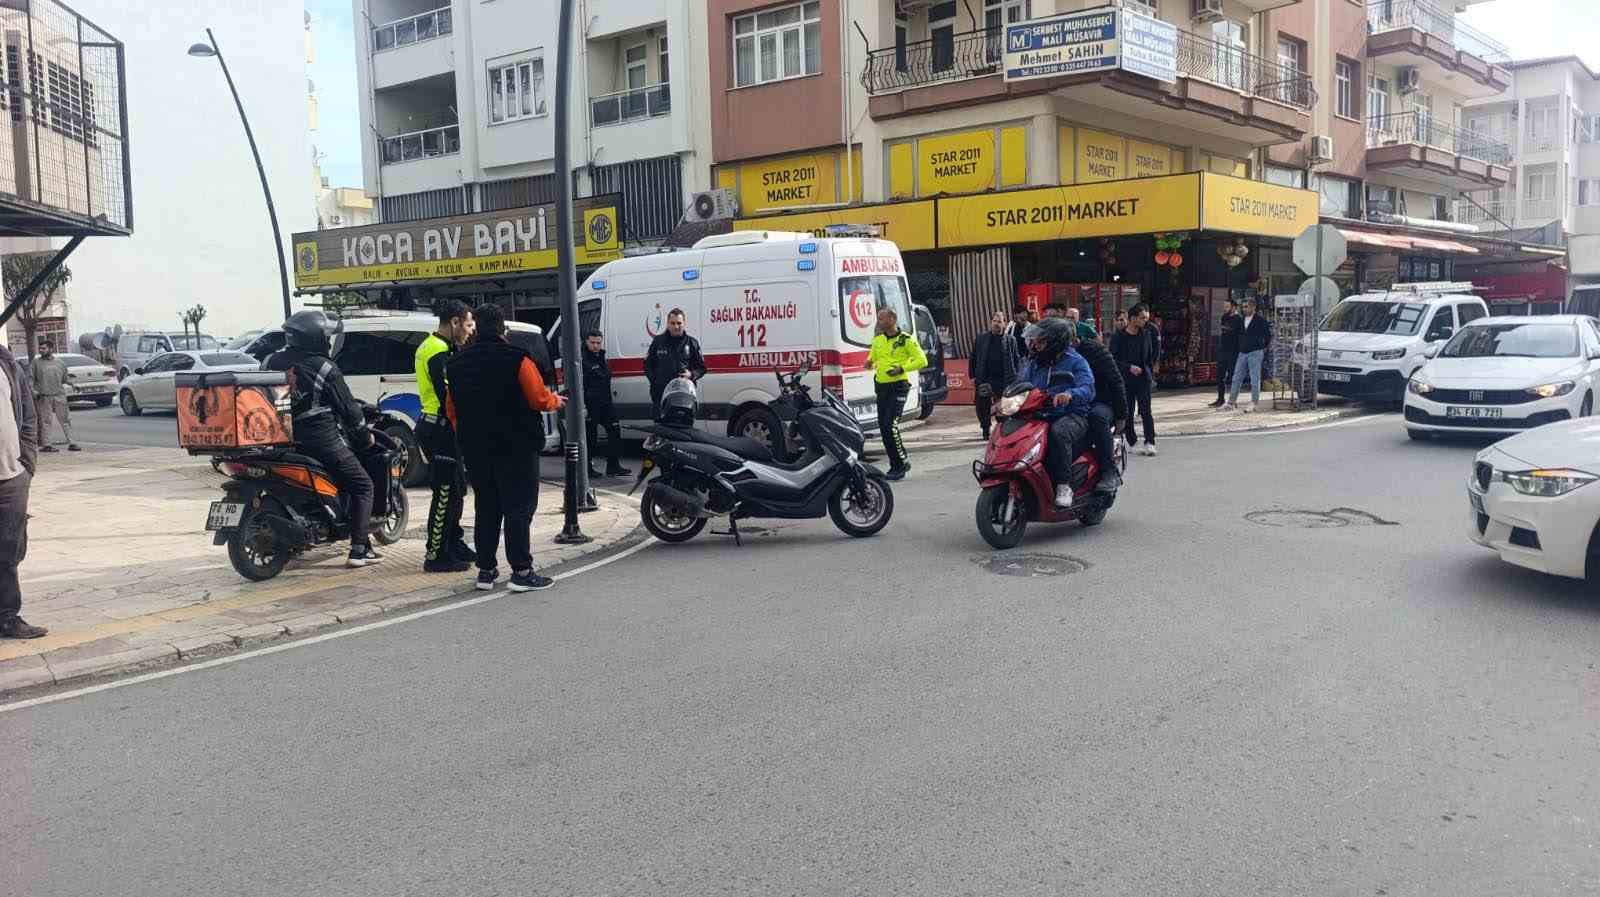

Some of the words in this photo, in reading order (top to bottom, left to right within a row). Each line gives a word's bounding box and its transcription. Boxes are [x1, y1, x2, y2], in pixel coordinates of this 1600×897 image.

[1020, 50, 1061, 66] Mehmet
[931, 151, 957, 165] STAR
[959, 147, 981, 161] 2011
[1086, 145, 1105, 159] STAR
[762, 170, 790, 186] STAR
[792, 167, 815, 182] 2011
[934, 162, 978, 178] MARKET
[1088, 161, 1116, 178] MARKET
[767, 185, 812, 202] MARKET
[986, 209, 1028, 228] STAR
[1031, 205, 1063, 224] 2011
[1067, 198, 1141, 221] MARKET
[1229, 196, 1250, 213] STAR
[1251, 199, 1268, 216] 2011
[1269, 202, 1298, 221] MARKET
[342, 231, 414, 267] KOCA
[423, 225, 464, 260] AV
[842, 259, 901, 273] AMBULANS
[744, 289, 761, 304] T.C.
[710, 305, 743, 323] SAĞLIK
[745, 301, 797, 321] BAKANLIĞI
[855, 302, 872, 316] 112
[737, 324, 767, 348] 112
[739, 351, 819, 367] AMBULANS
